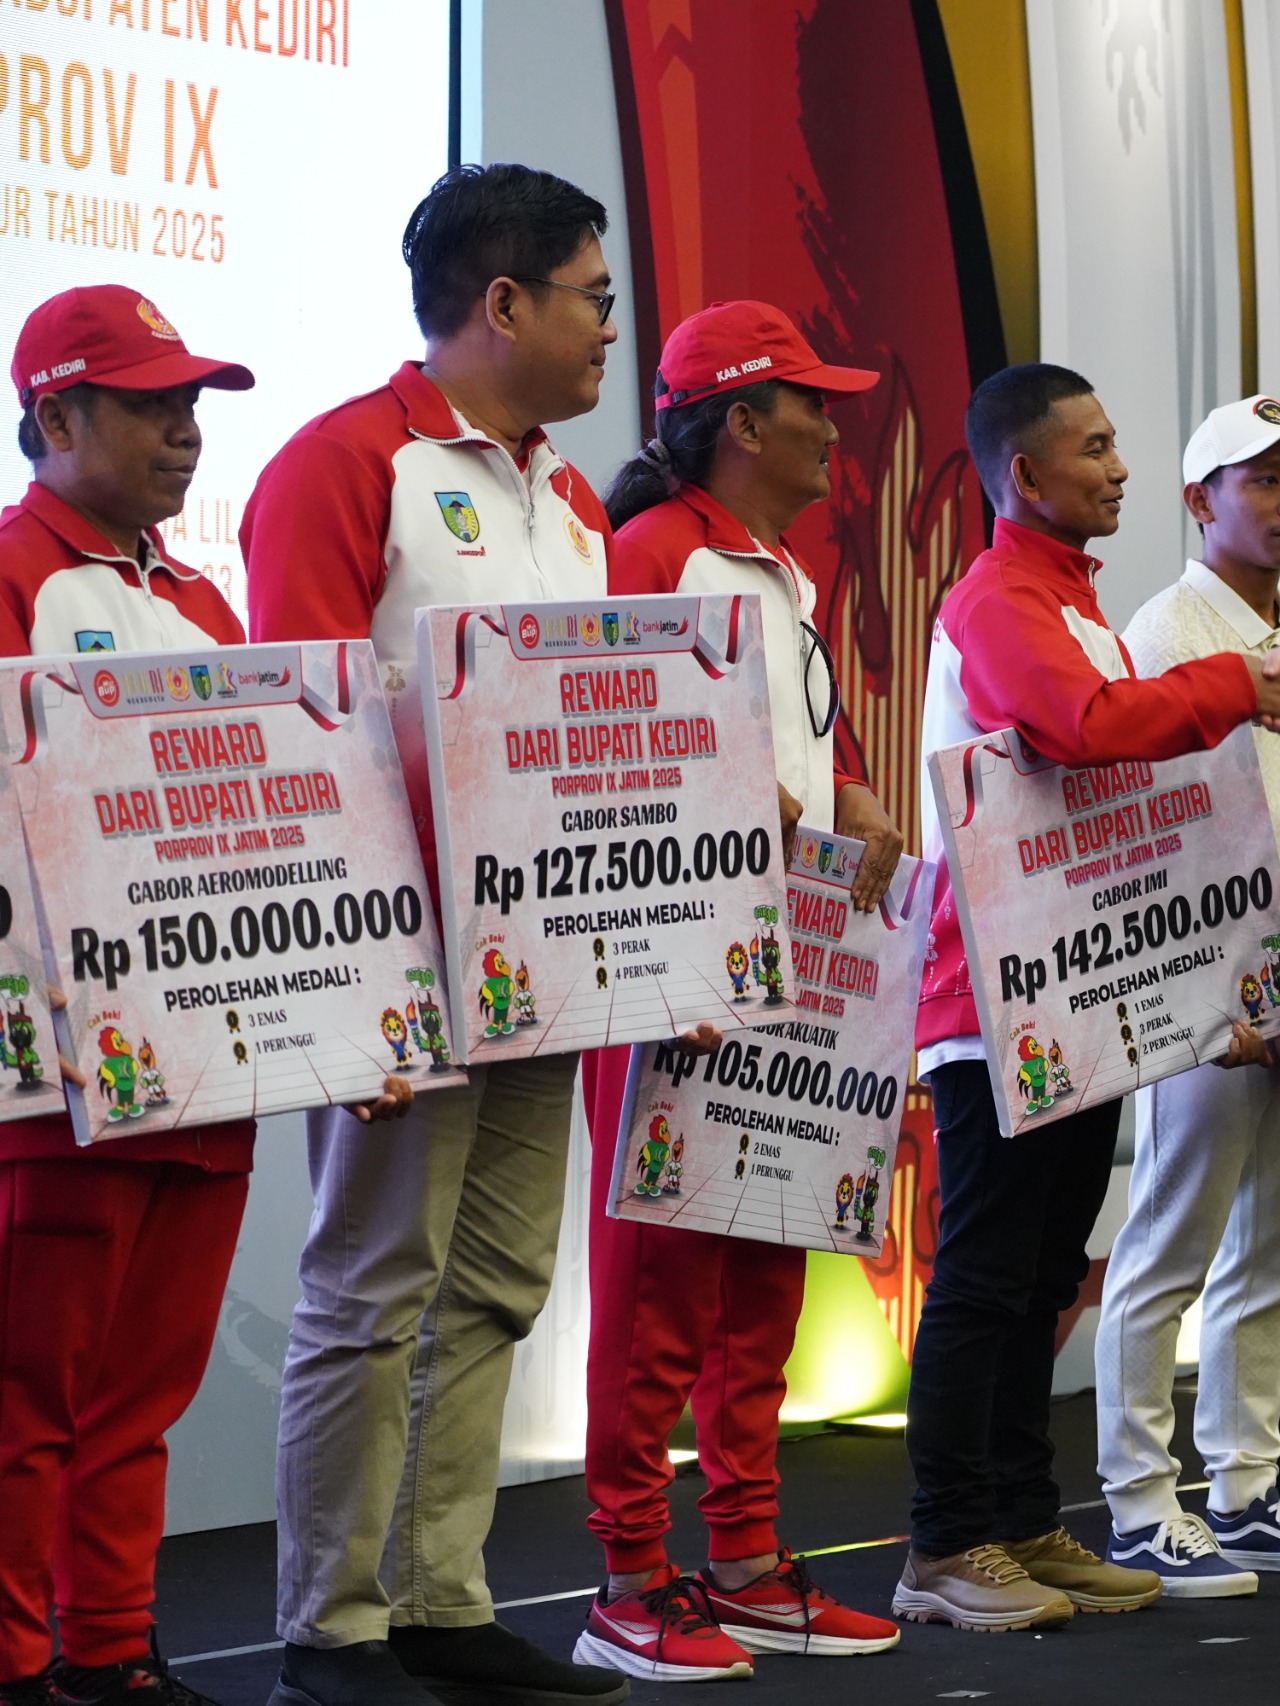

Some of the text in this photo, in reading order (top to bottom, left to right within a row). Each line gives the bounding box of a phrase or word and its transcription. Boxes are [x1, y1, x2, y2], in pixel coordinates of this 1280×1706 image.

[225, 0, 349, 67] KEDIRI
[164, 78, 219, 190] IX
[45, 189, 139, 253] TAHUN
[152, 206, 225, 263] 2025
[30, 357, 86, 388] KAB. KEDIRI
[715, 356, 773, 382] KAB. KEDIRI
[559, 667, 658, 714] REWARD
[150, 722, 268, 773] REWARD
[505, 716, 718, 770] DARI BUPATI KEDIRI
[95, 771, 342, 834] DARI BUPATI KEDIRI
[551, 767, 683, 798] PORPROV IX JATIM 2025
[1061, 761, 1154, 815] REWARD
[561, 801, 678, 833] CABOR SAMBO
[1017, 781, 1213, 875] DARI BUPATI KEDIRI
[155, 825, 305, 861] PORPROV IX JATIM 2025
[1063, 833, 1183, 888] PORPROV IX JATIM 2025
[127, 857, 348, 905] CABOR AEROMODELLING
[474, 827, 771, 915] Rp 127.500.000
[1092, 868, 1169, 912] CABOR IMI
[71, 885, 423, 990] Rp 150.000.000
[543, 911, 644, 938] PEROLEHAN
[648, 902, 707, 930] MEDALI
[999, 866, 1274, 1005] Rp 142.500.000
[612, 938, 651, 956] 3 PERAK
[164, 974, 280, 1012] PEROLEHAN
[284, 967, 352, 996] MEDALI
[615, 961, 670, 980] 4 PERUNGGU
[826, 950, 879, 998] KEDIRI
[1068, 972, 1161, 1014] PEROLEHAN
[1162, 949, 1216, 982] MEDALI
[247, 1009, 288, 1028] 3 EMAS
[795, 988, 846, 1017] JATIM 2025
[1134, 993, 1164, 1014] 1 EMAS
[1139, 1012, 1174, 1035] 3 PERAK
[255, 1033, 317, 1055] 1 PERUNGGU
[785, 1021, 839, 1050] AKUATIK
[1142, 1026, 1196, 1055] 2 PERUNGGU
[703, 1040, 898, 1121] 105.000.000
[705, 1100, 785, 1136] PEROLEHAN
[786, 1119, 835, 1144] MEDALI
[751, 1163, 794, 1182] 1 PERUNGGU
[753, 1142, 782, 1159] 2 EMAS
